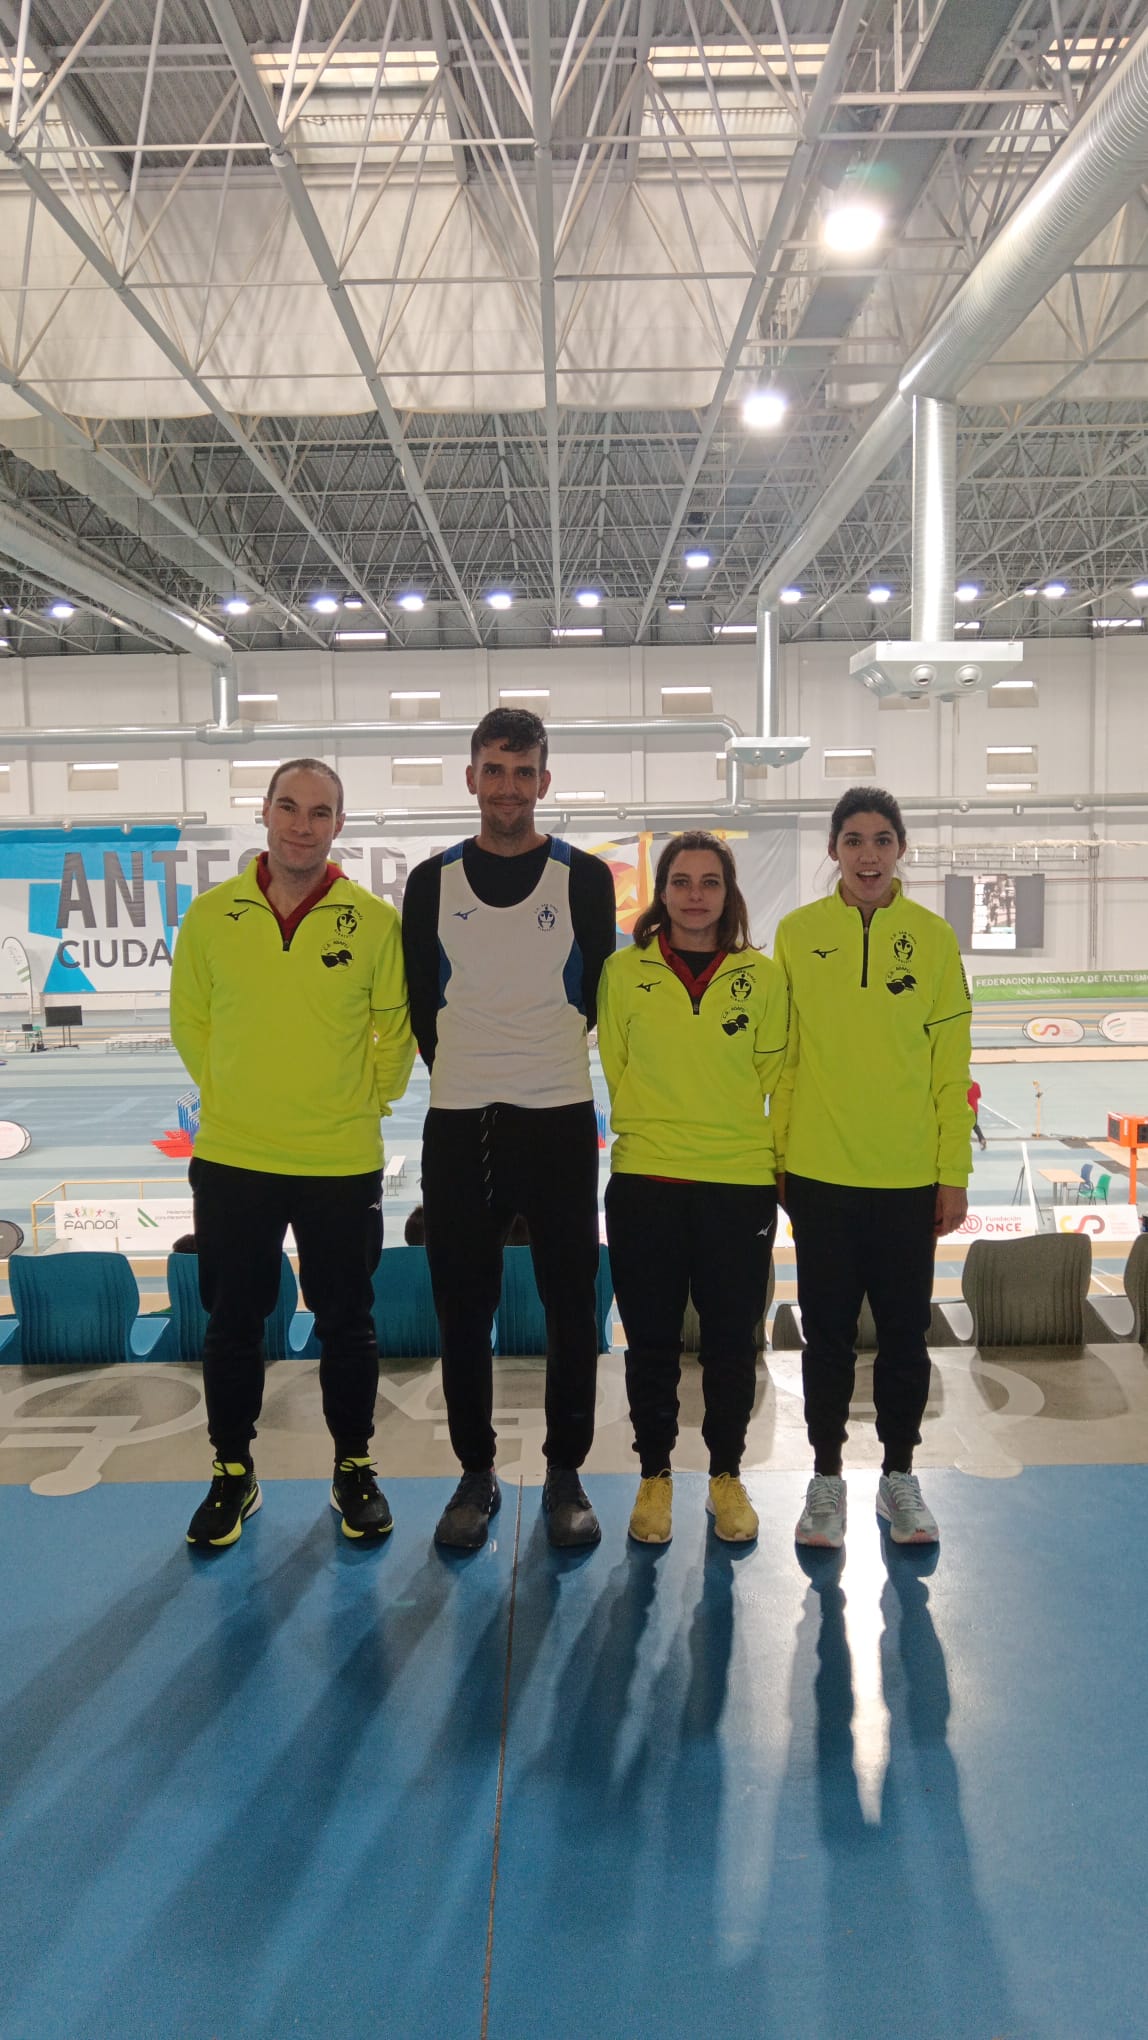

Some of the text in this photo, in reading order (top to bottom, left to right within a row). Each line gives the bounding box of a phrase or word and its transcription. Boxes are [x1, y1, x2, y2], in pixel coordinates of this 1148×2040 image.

[1036, 974, 1085, 985] ANDALUZA
[1087, 974, 1100, 984] DE
[1102, 973, 1148, 984] ATLETISM
[986, 1223, 1021, 1232] ONCE
